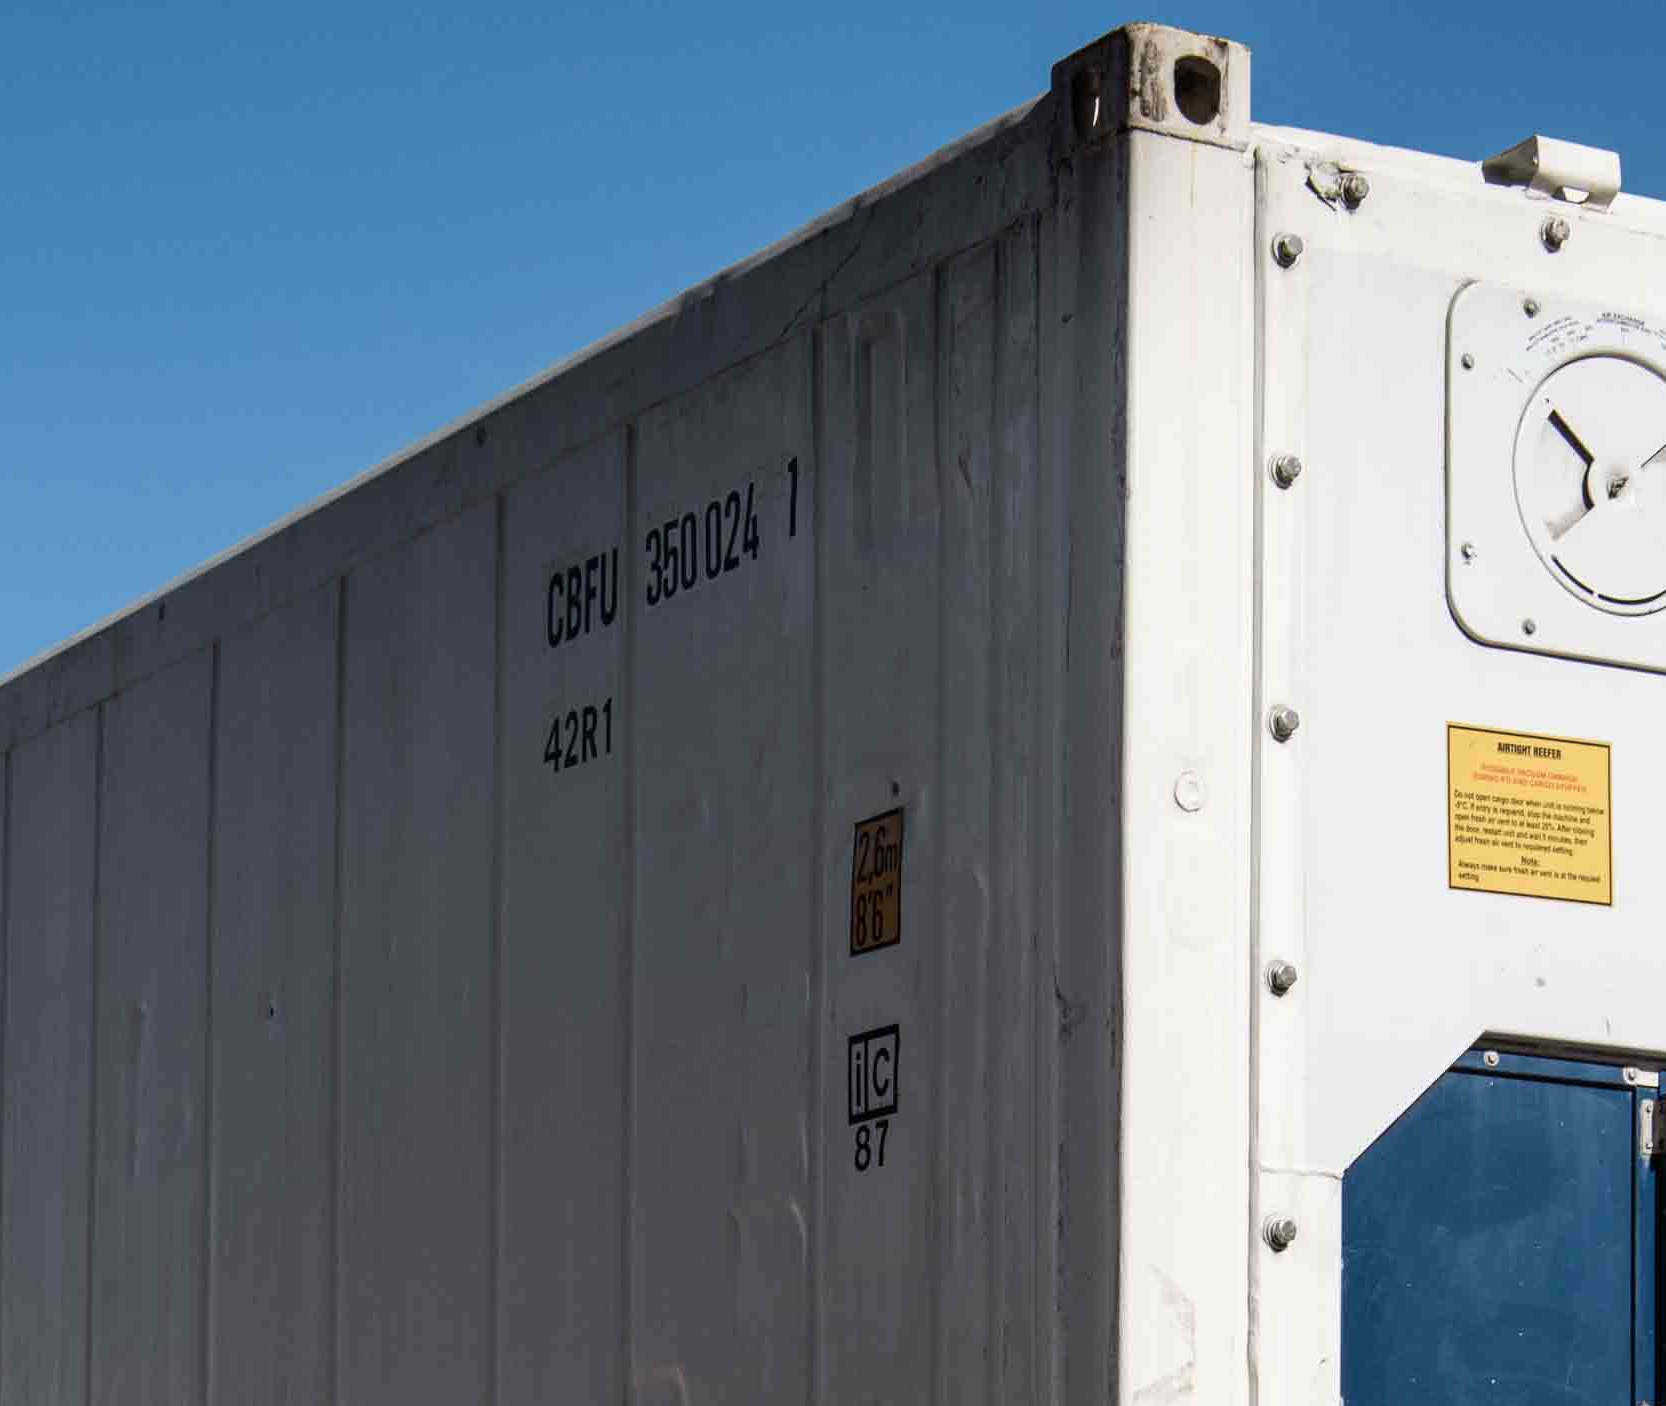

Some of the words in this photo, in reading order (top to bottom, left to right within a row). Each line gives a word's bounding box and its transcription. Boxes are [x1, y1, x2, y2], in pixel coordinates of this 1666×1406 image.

[548, 547, 617, 647] CBFU
[788, 455, 798, 536] 1
[543, 697, 612, 773] 42R1
[1497, 742, 1531, 757] AIRTIGHT
[1533, 746, 1561, 760] REEFER
[855, 1119, 889, 1171] 87
